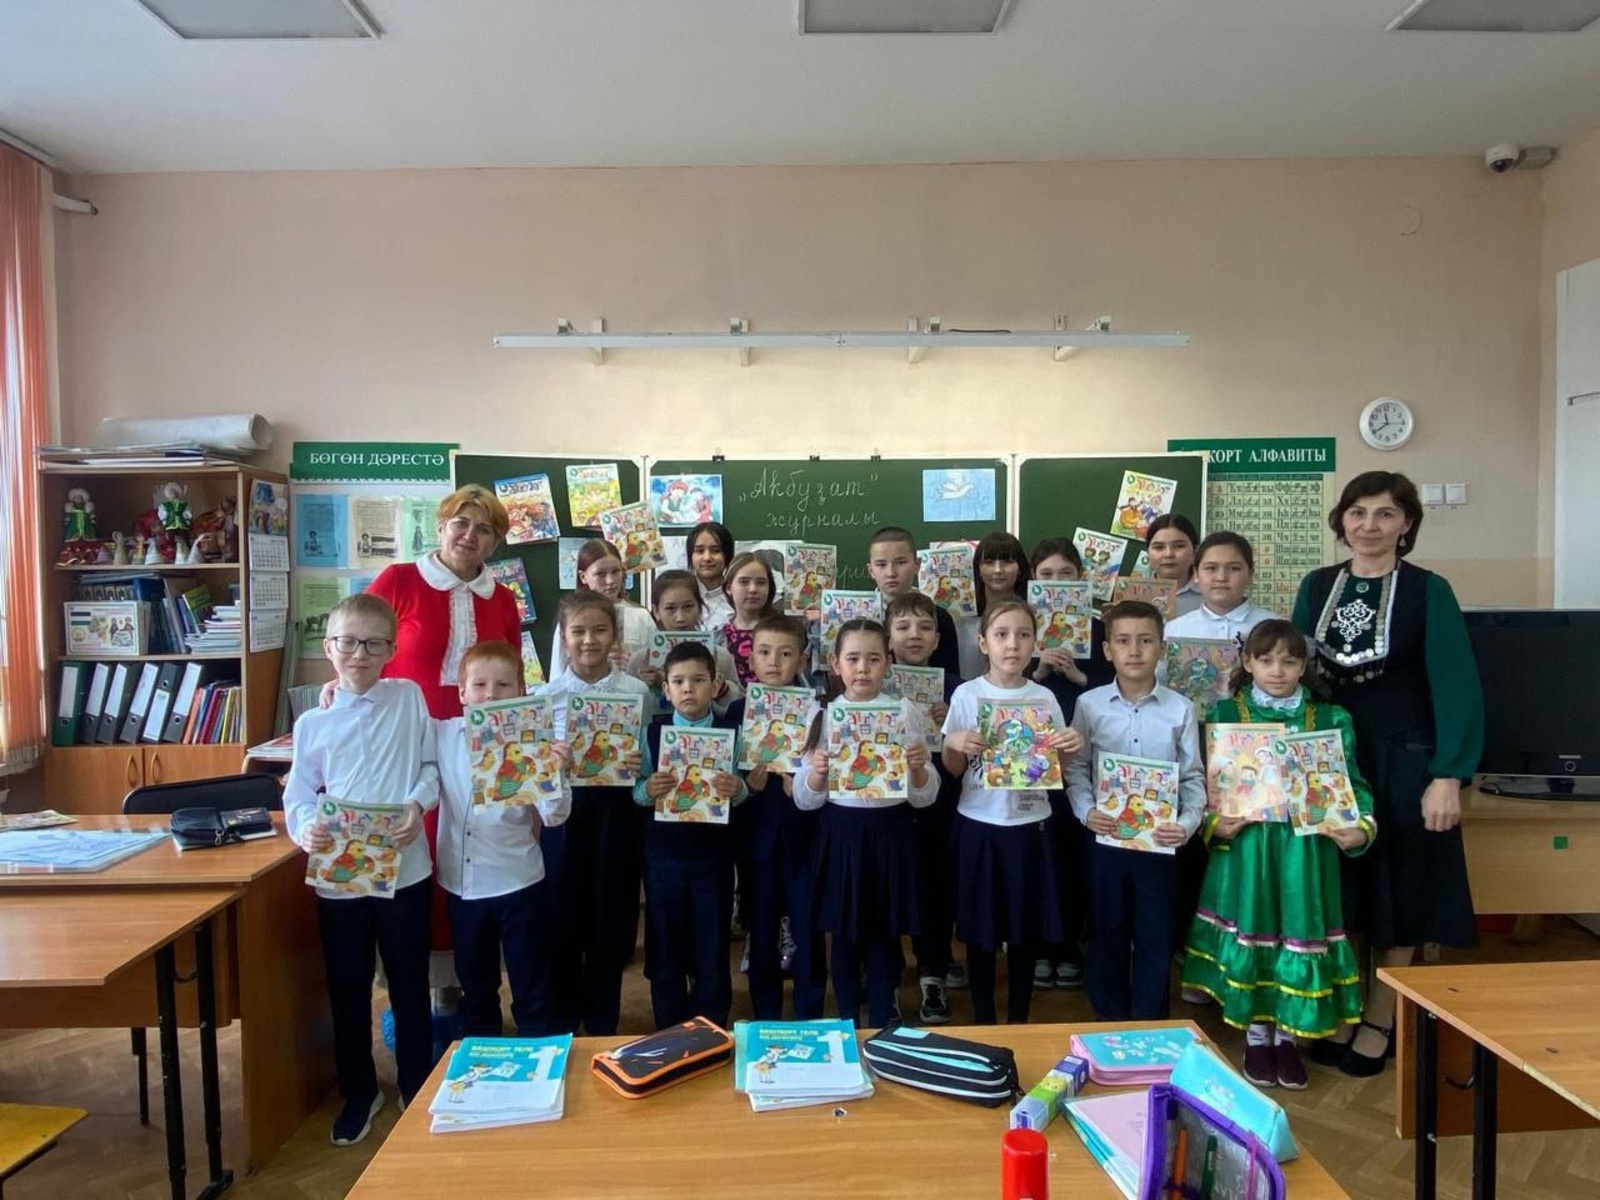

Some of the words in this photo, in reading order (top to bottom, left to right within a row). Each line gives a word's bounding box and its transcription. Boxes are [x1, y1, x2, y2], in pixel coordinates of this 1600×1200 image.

[309, 453, 364, 465] БӨГӨН
[367, 453, 445, 466] ДӘРЕСТӘ
[1248, 448, 1327, 463] АЛФАВИТЫ
[765, 511, 880, 537] журналы
